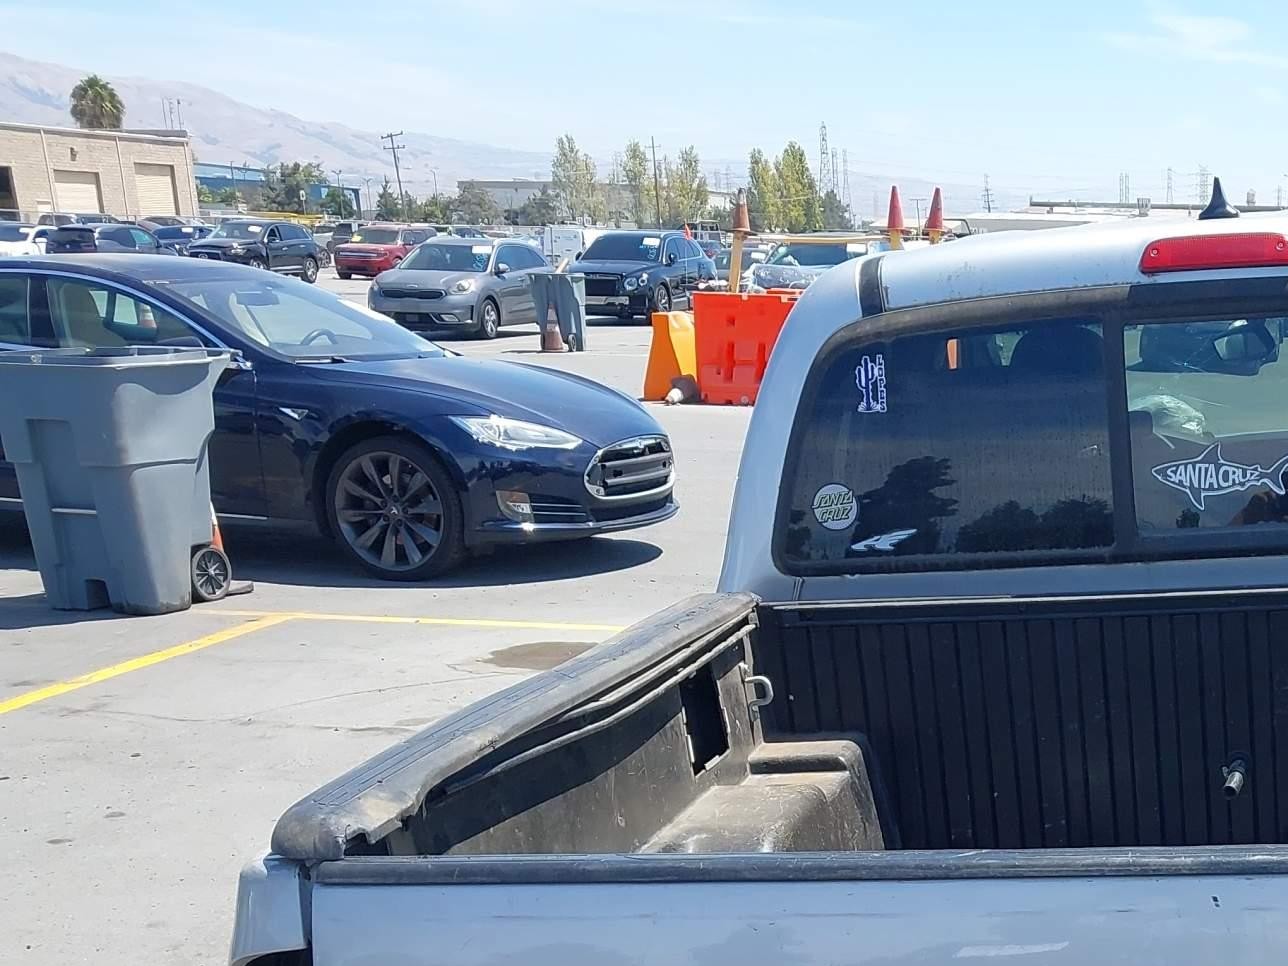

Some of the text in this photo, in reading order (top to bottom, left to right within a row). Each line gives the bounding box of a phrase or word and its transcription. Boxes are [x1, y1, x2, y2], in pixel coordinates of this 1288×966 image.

[1166, 463, 1259, 488] SANTA CRUZ
[812, 489, 853, 509] SANTA
[819, 505, 852, 523] CRUZ
